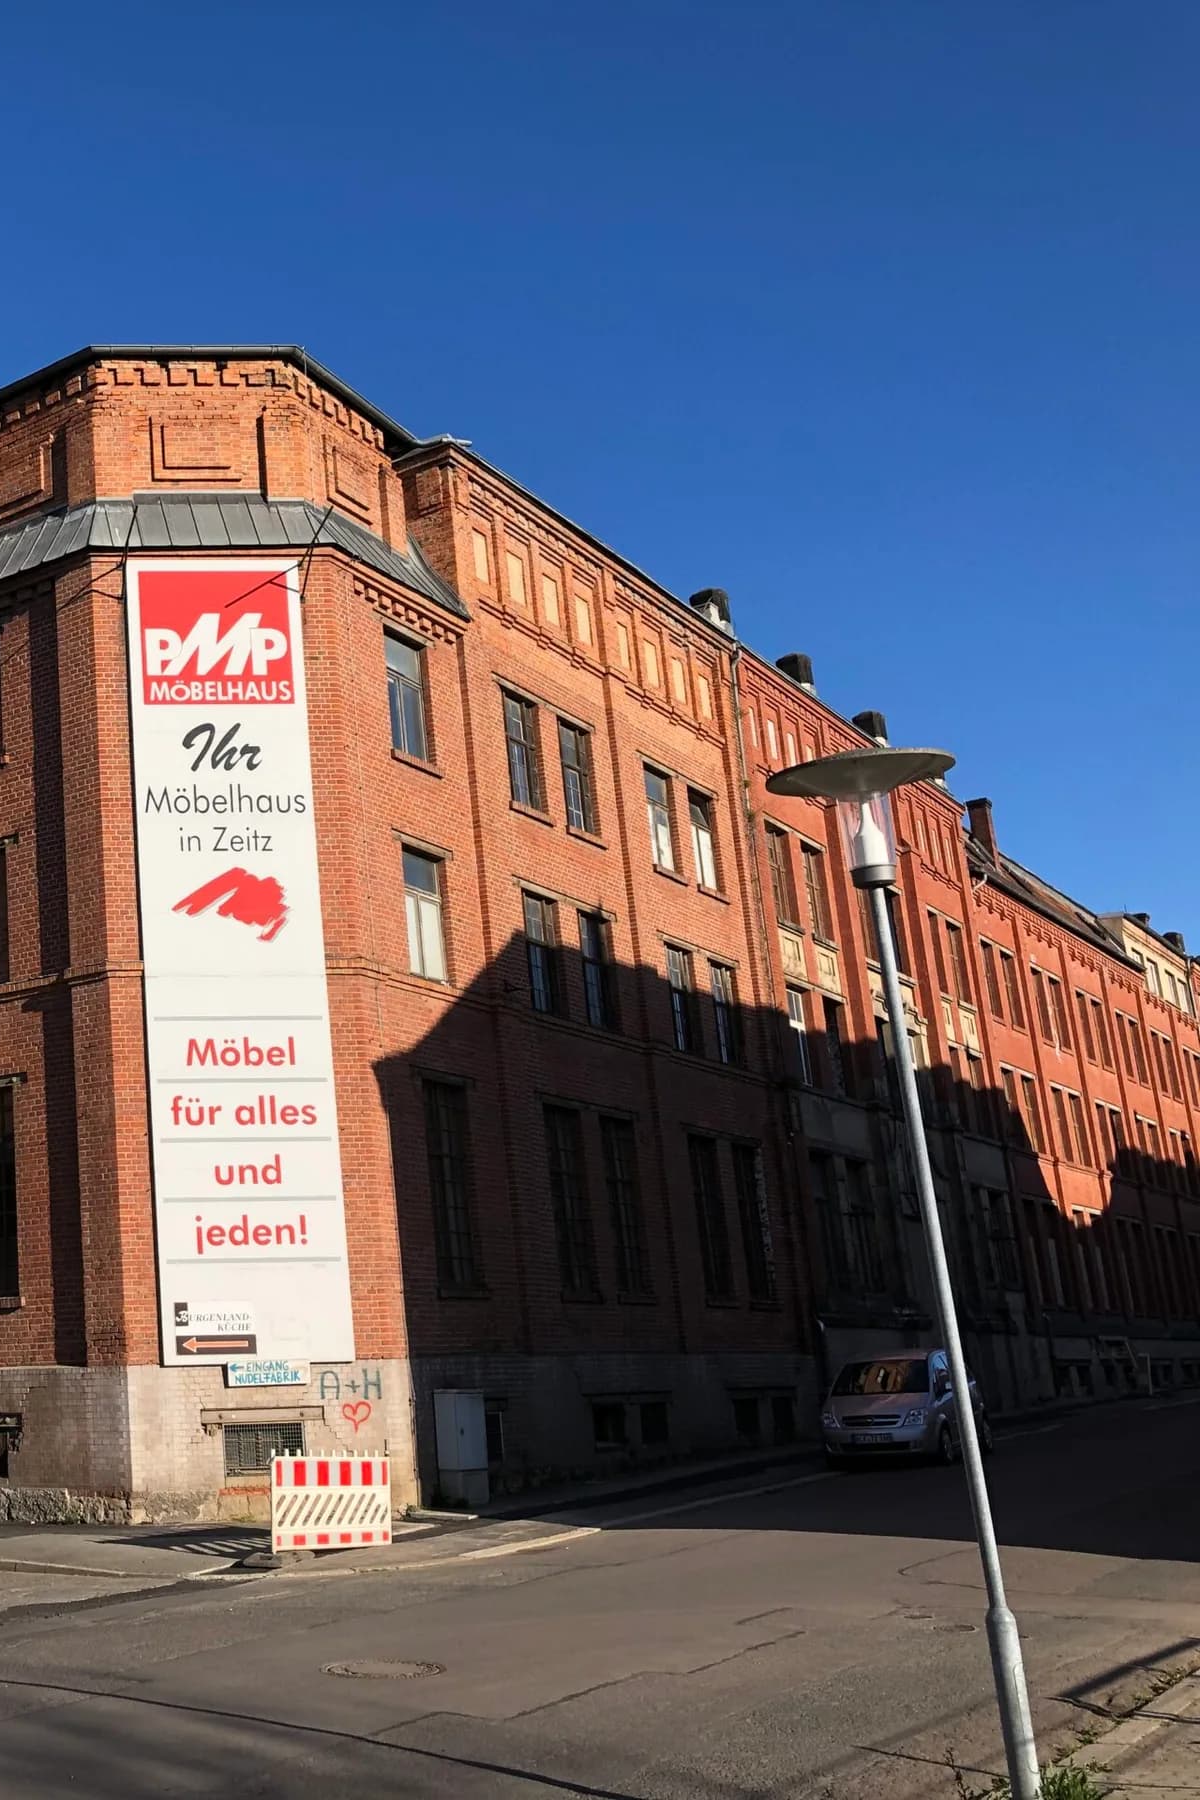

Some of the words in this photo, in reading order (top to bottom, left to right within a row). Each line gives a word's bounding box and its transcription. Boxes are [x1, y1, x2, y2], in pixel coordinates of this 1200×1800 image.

[144, 612, 288, 676] PMP
[150, 680, 291, 702] MÖBELHAUS
[182, 723, 262, 771] Ihr
[145, 783, 306, 814] Möbelhaus
[179, 827, 201, 852] in
[212, 826, 273, 852] Zeitz
[186, 1036, 296, 1066] Möbel
[171, 1095, 222, 1126] für
[235, 1095, 318, 1125] alles
[214, 1154, 282, 1185] und
[195, 1215, 308, 1255] jeden!
[246, 1360, 289, 1372] EINGANG
